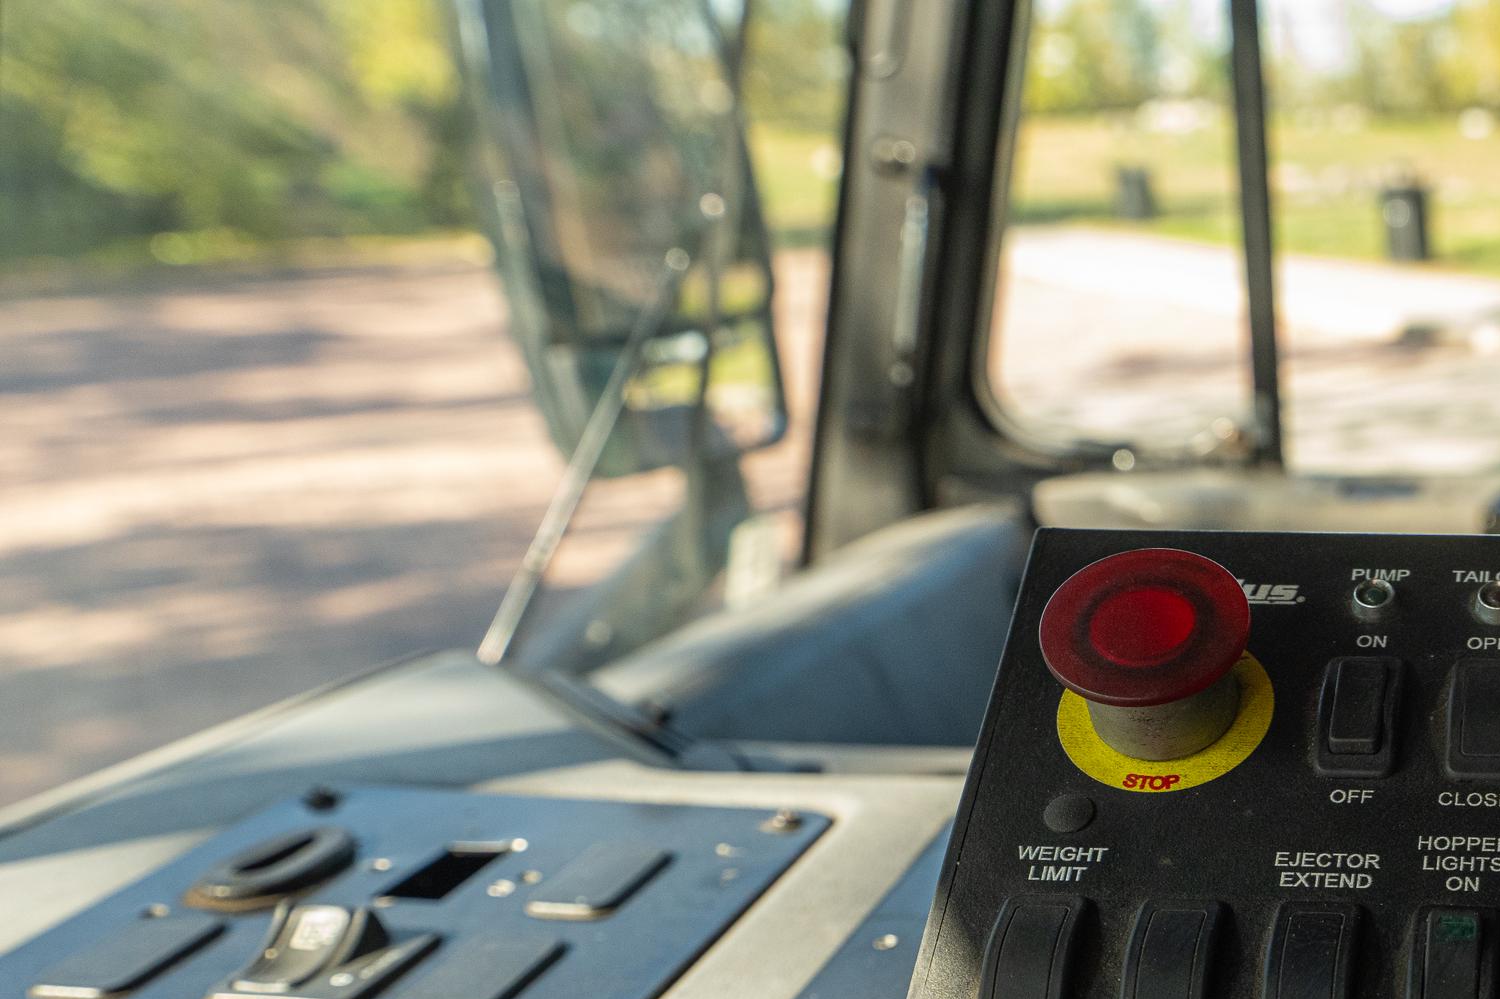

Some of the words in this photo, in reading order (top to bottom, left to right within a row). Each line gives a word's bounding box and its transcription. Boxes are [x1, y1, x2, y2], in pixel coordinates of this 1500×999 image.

[1352, 568, 1410, 583] PUMP
[1357, 635, 1387, 647] ON
[1122, 773, 1181, 790] STOP
[1330, 790, 1374, 803] OFF
[1019, 846, 1108, 862] WEIGHT
[1275, 852, 1380, 868] EJECTOR
[1028, 866, 1087, 881] LIMIT
[1280, 872, 1372, 888] EXTEND
[1446, 877, 1479, 891] ON
